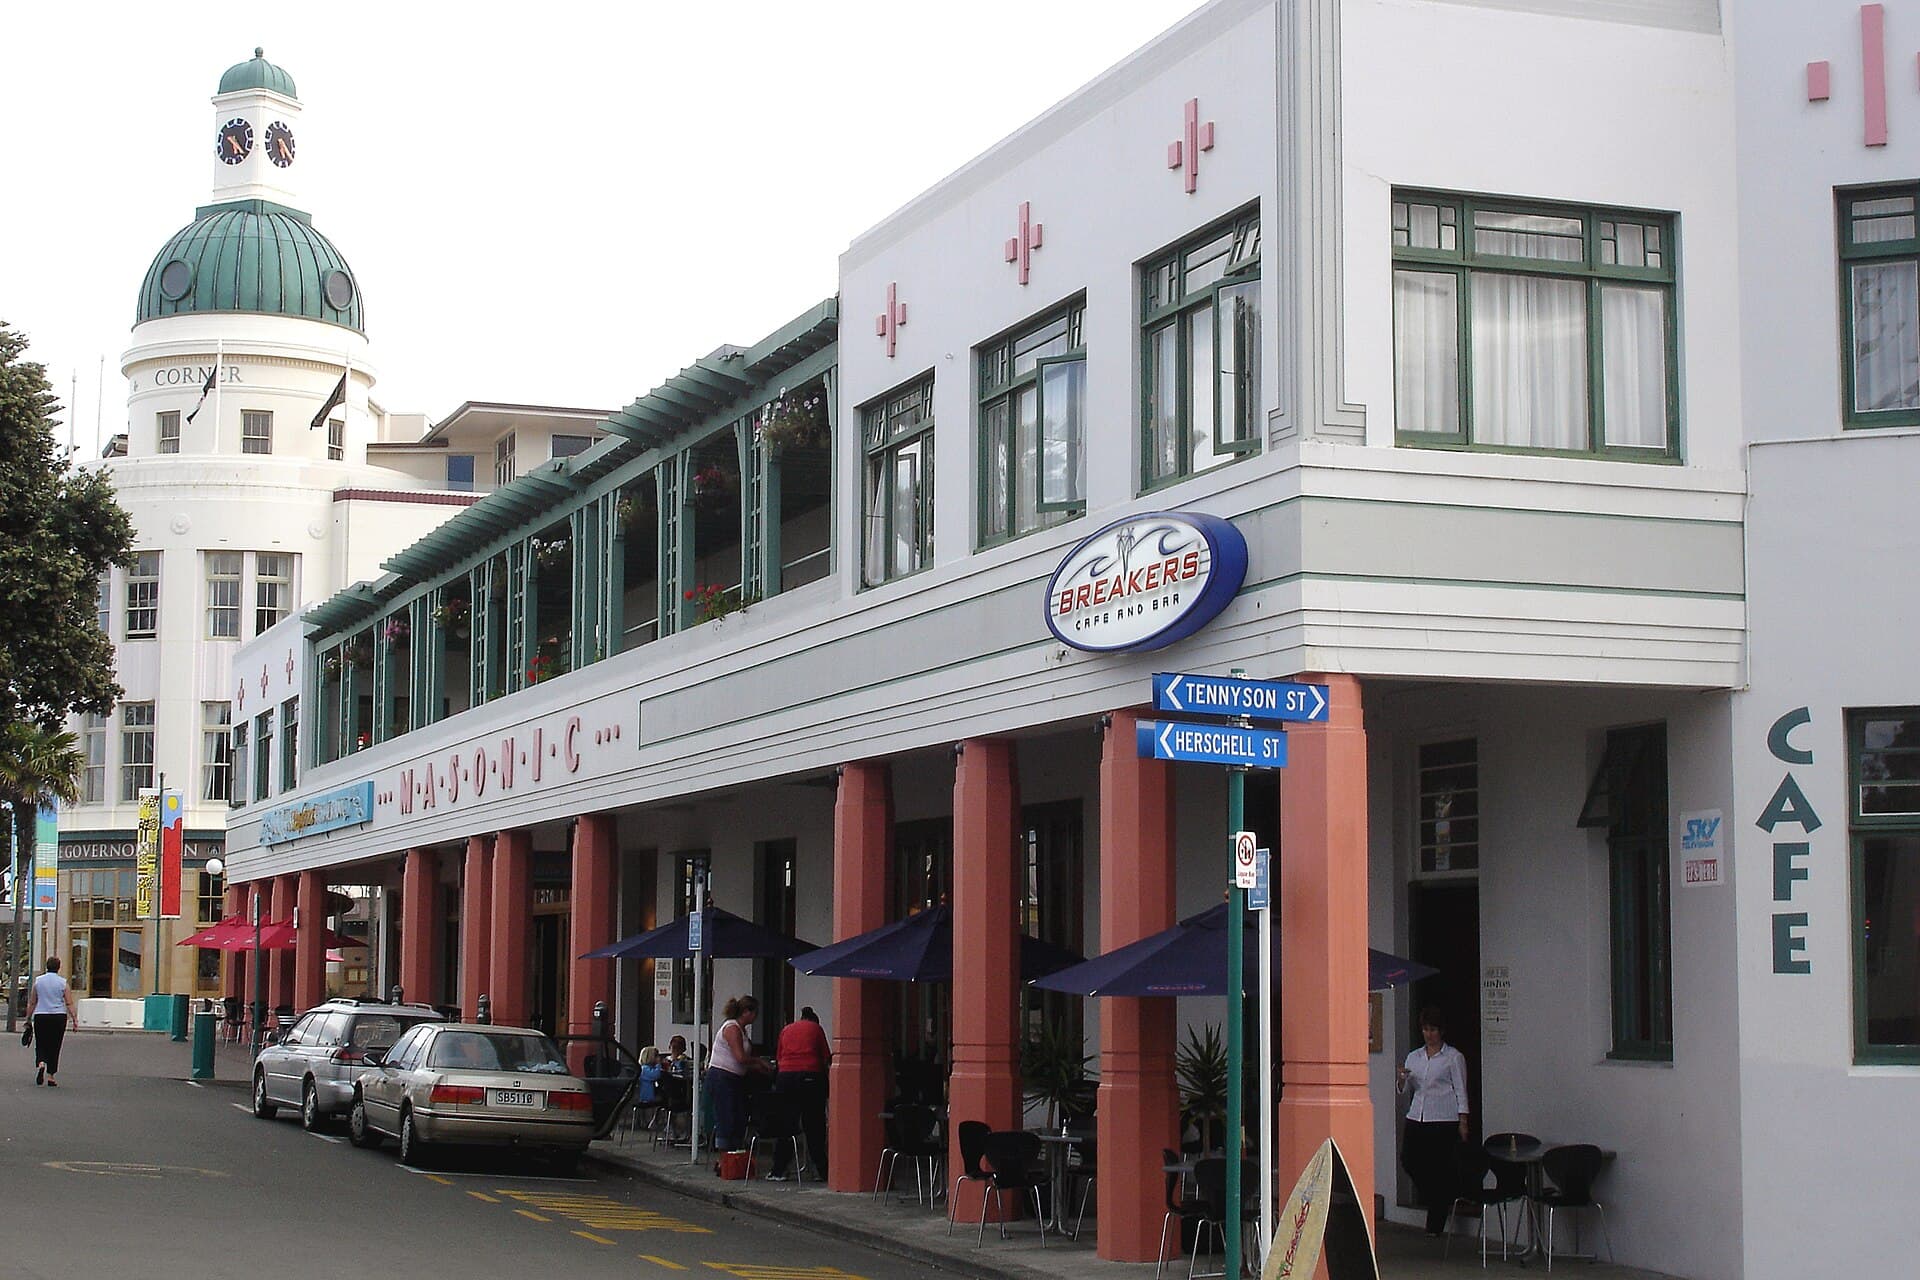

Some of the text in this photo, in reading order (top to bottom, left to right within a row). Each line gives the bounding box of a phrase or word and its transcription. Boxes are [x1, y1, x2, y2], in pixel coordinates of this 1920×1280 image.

[155, 366, 243, 386] CORNER
[1059, 551, 1200, 615] BREAKERS
[1075, 593, 1181, 631] CAFE AND BAR
[1186, 683, 1307, 711] TENNYSON ST
[1175, 730, 1280, 759] HERSCHELL ST
[1755, 706, 1822, 974] CAFE
